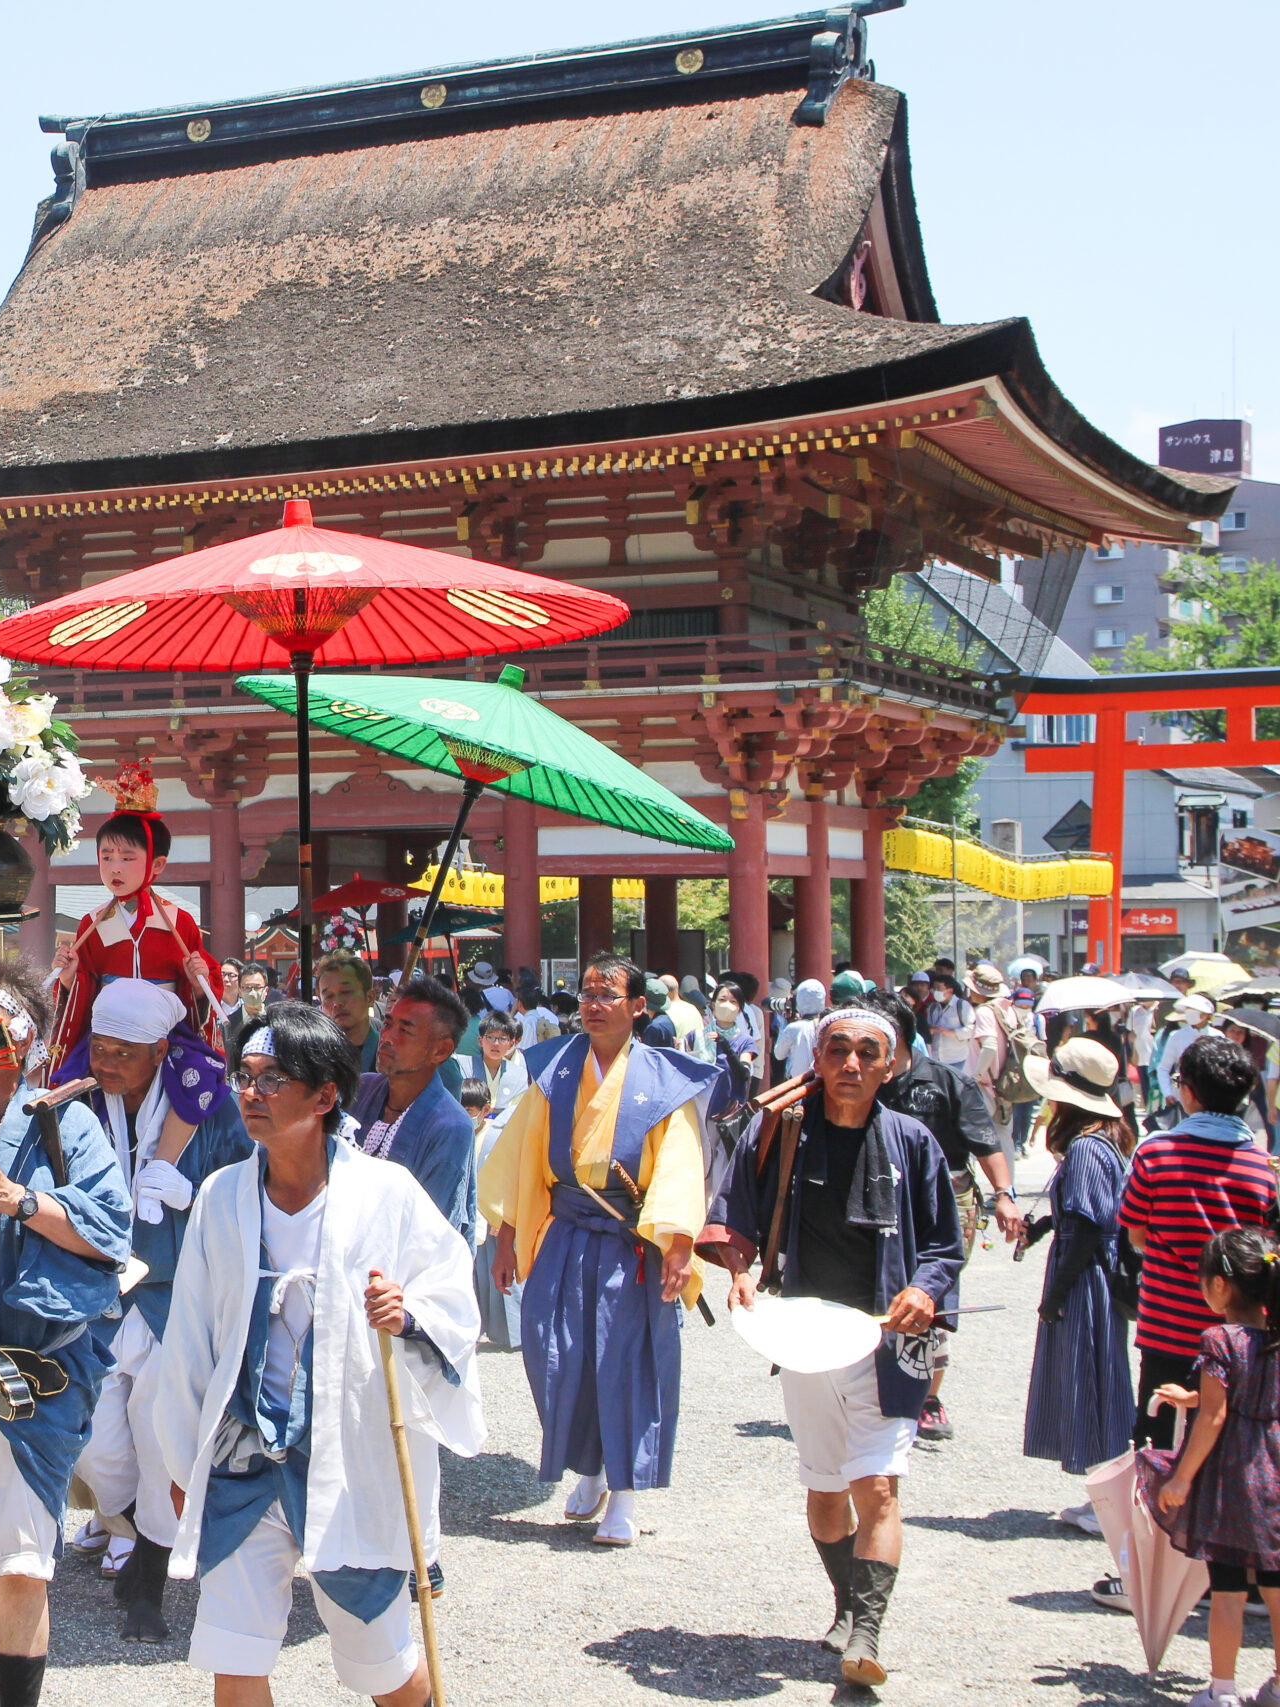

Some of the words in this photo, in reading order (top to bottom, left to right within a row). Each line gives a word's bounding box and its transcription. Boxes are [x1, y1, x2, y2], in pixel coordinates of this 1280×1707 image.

[1165, 434, 1211, 447] サンハウス
[1209, 448, 1234, 464] 津島
